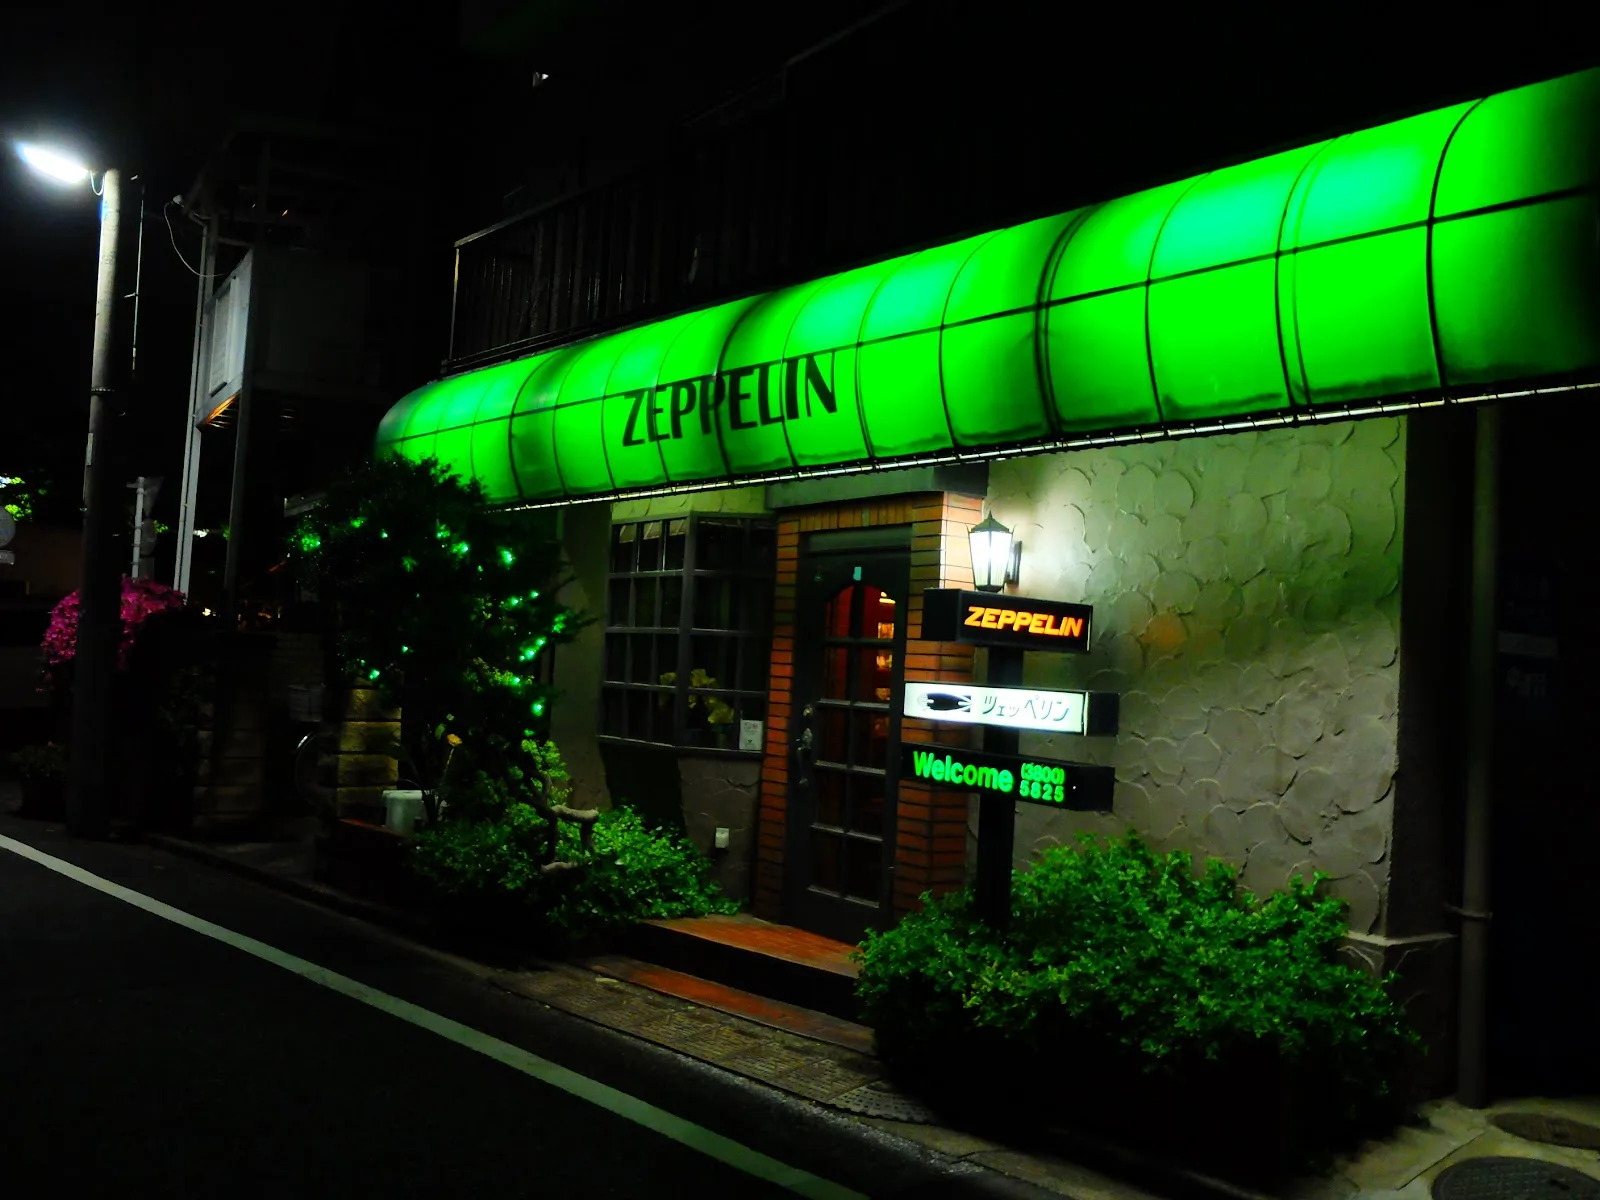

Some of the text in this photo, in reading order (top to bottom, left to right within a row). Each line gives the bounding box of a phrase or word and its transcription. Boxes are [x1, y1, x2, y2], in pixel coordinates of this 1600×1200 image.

[622, 350, 838, 447] ZEPPELIN
[964, 606, 1083, 637] ZEPPELIN
[982, 694, 1070, 722] ツェッペリン
[913, 751, 1014, 792] Welcome
[1019, 779, 1065, 803] 5825
